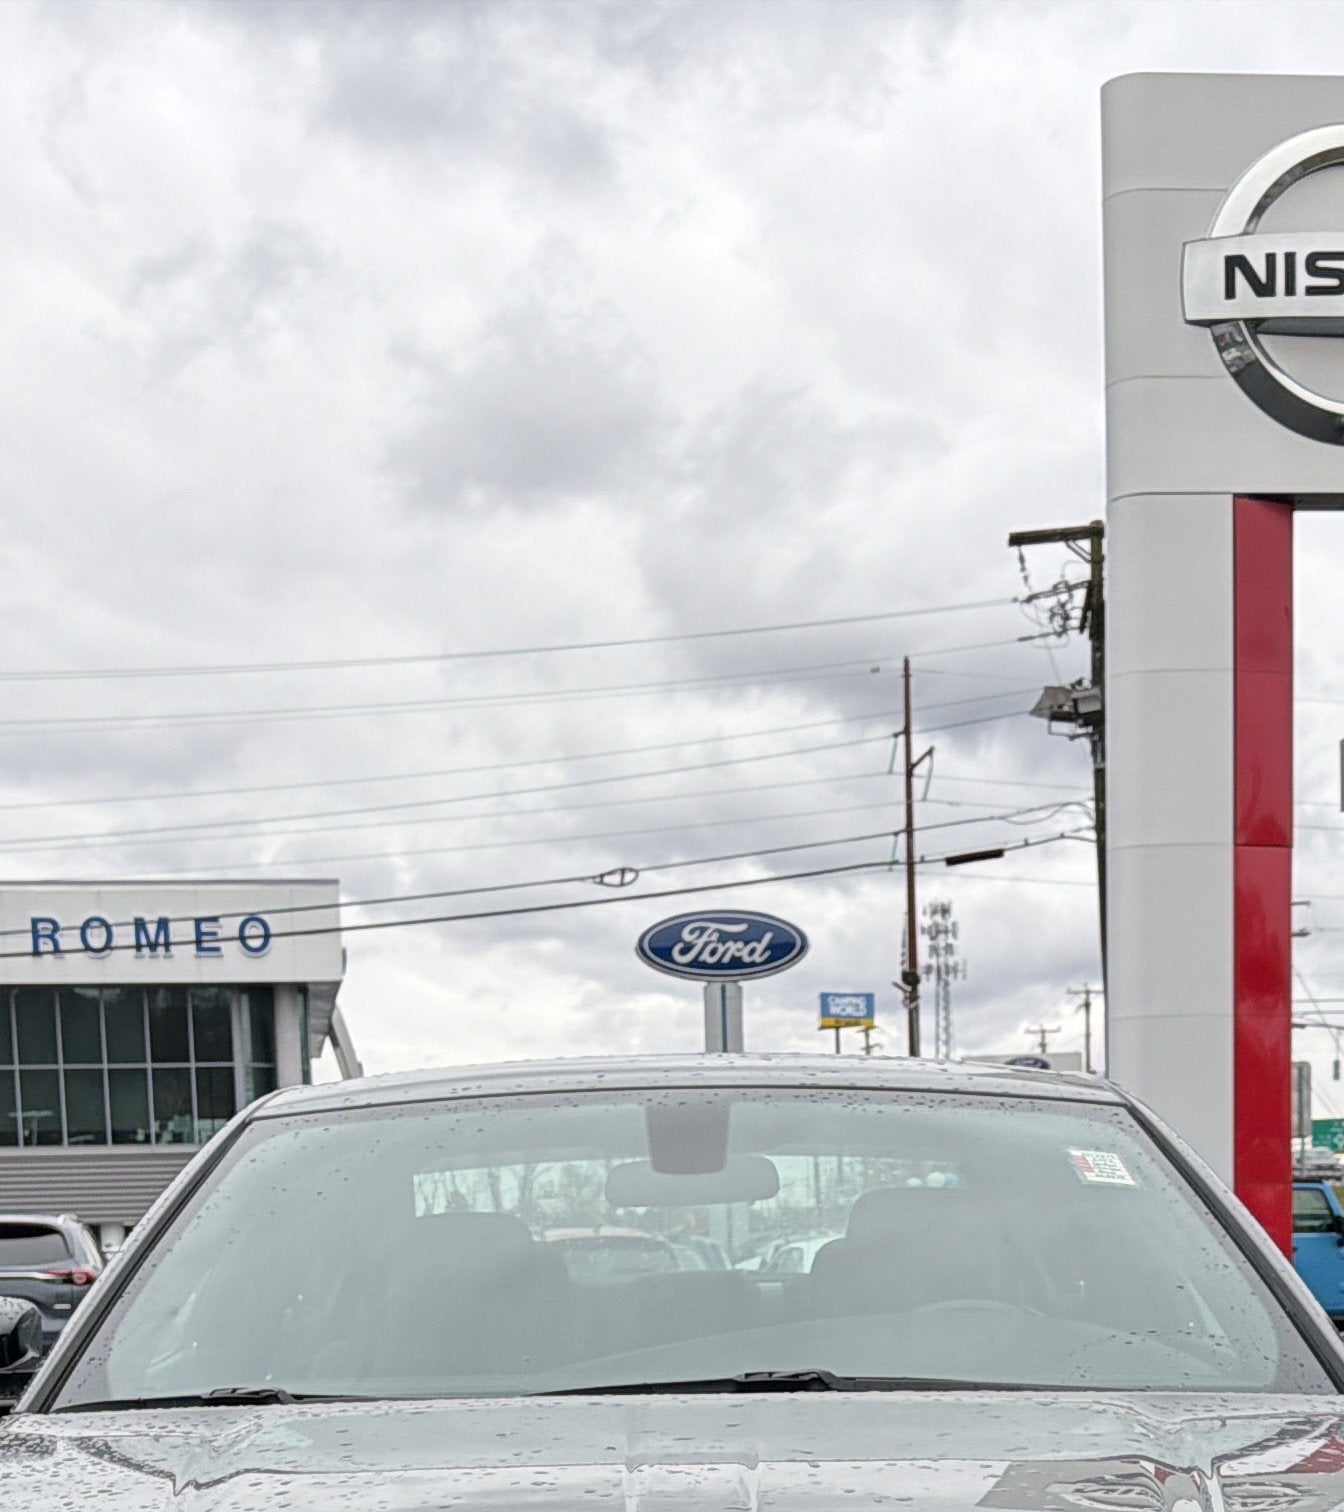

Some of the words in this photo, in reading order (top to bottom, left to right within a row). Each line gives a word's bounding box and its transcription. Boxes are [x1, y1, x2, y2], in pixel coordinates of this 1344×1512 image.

[30, 914, 272, 955] ROMEO
[671, 921, 774, 964] Ford
[829, 1006, 868, 1017] WORLD
